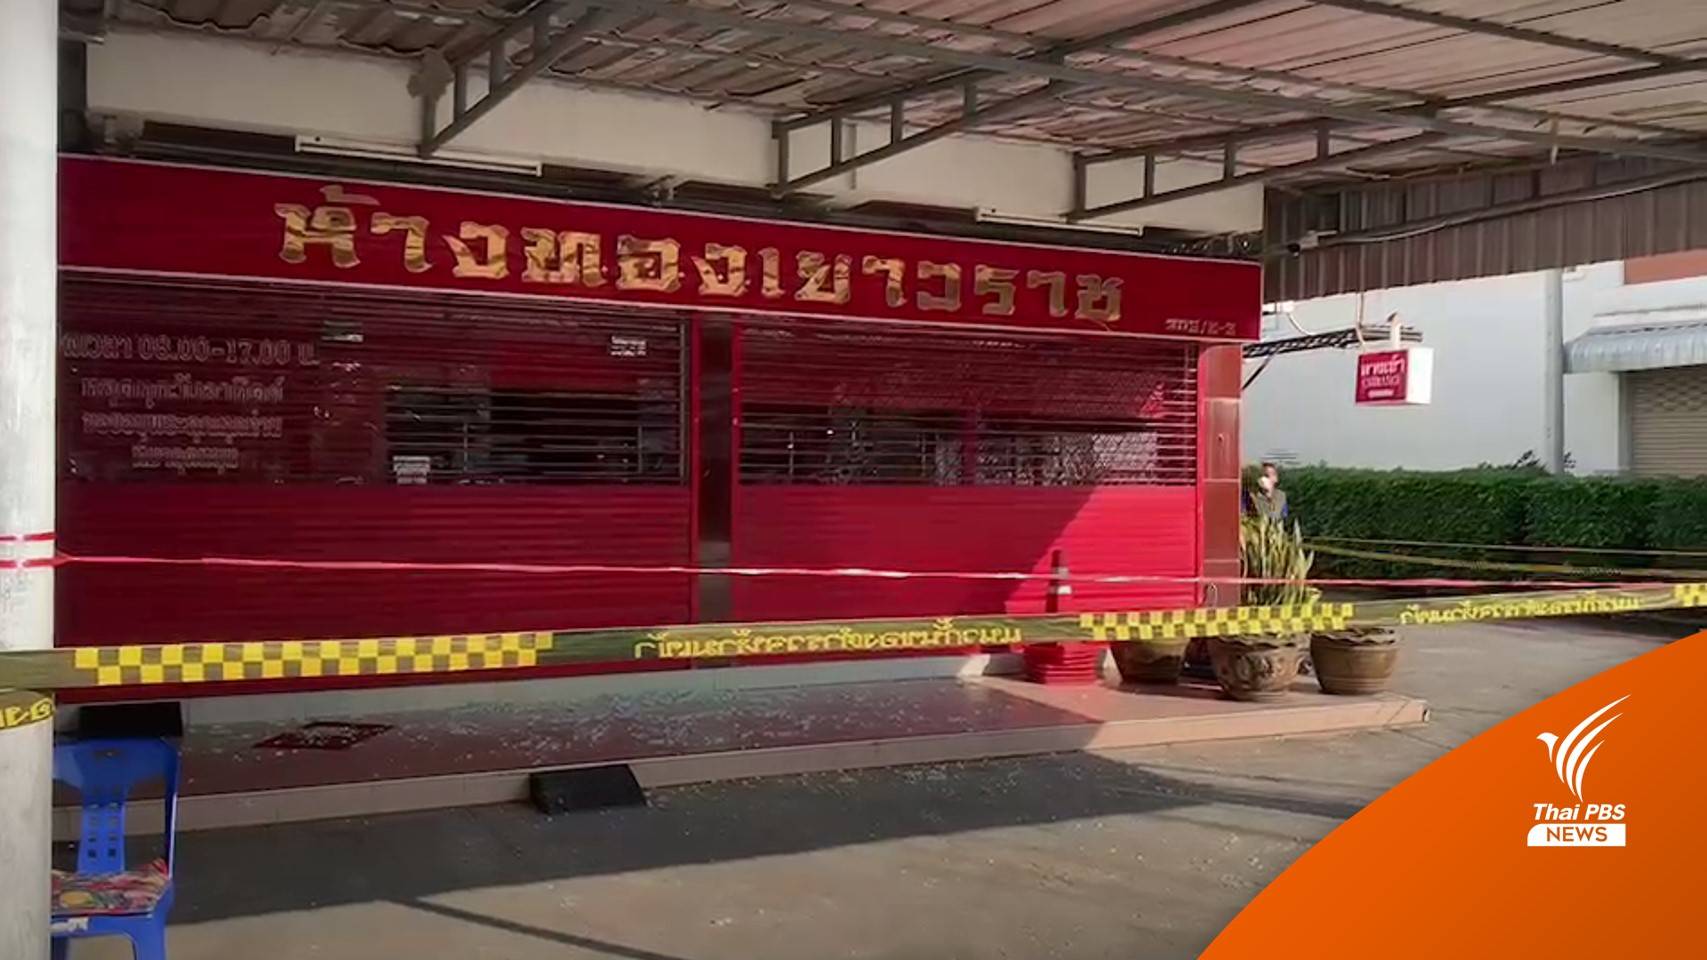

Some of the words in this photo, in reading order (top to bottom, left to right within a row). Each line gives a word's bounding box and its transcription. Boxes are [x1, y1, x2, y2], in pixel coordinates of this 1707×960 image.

[274, 185, 1124, 322] ห้างทองเยาวราช
